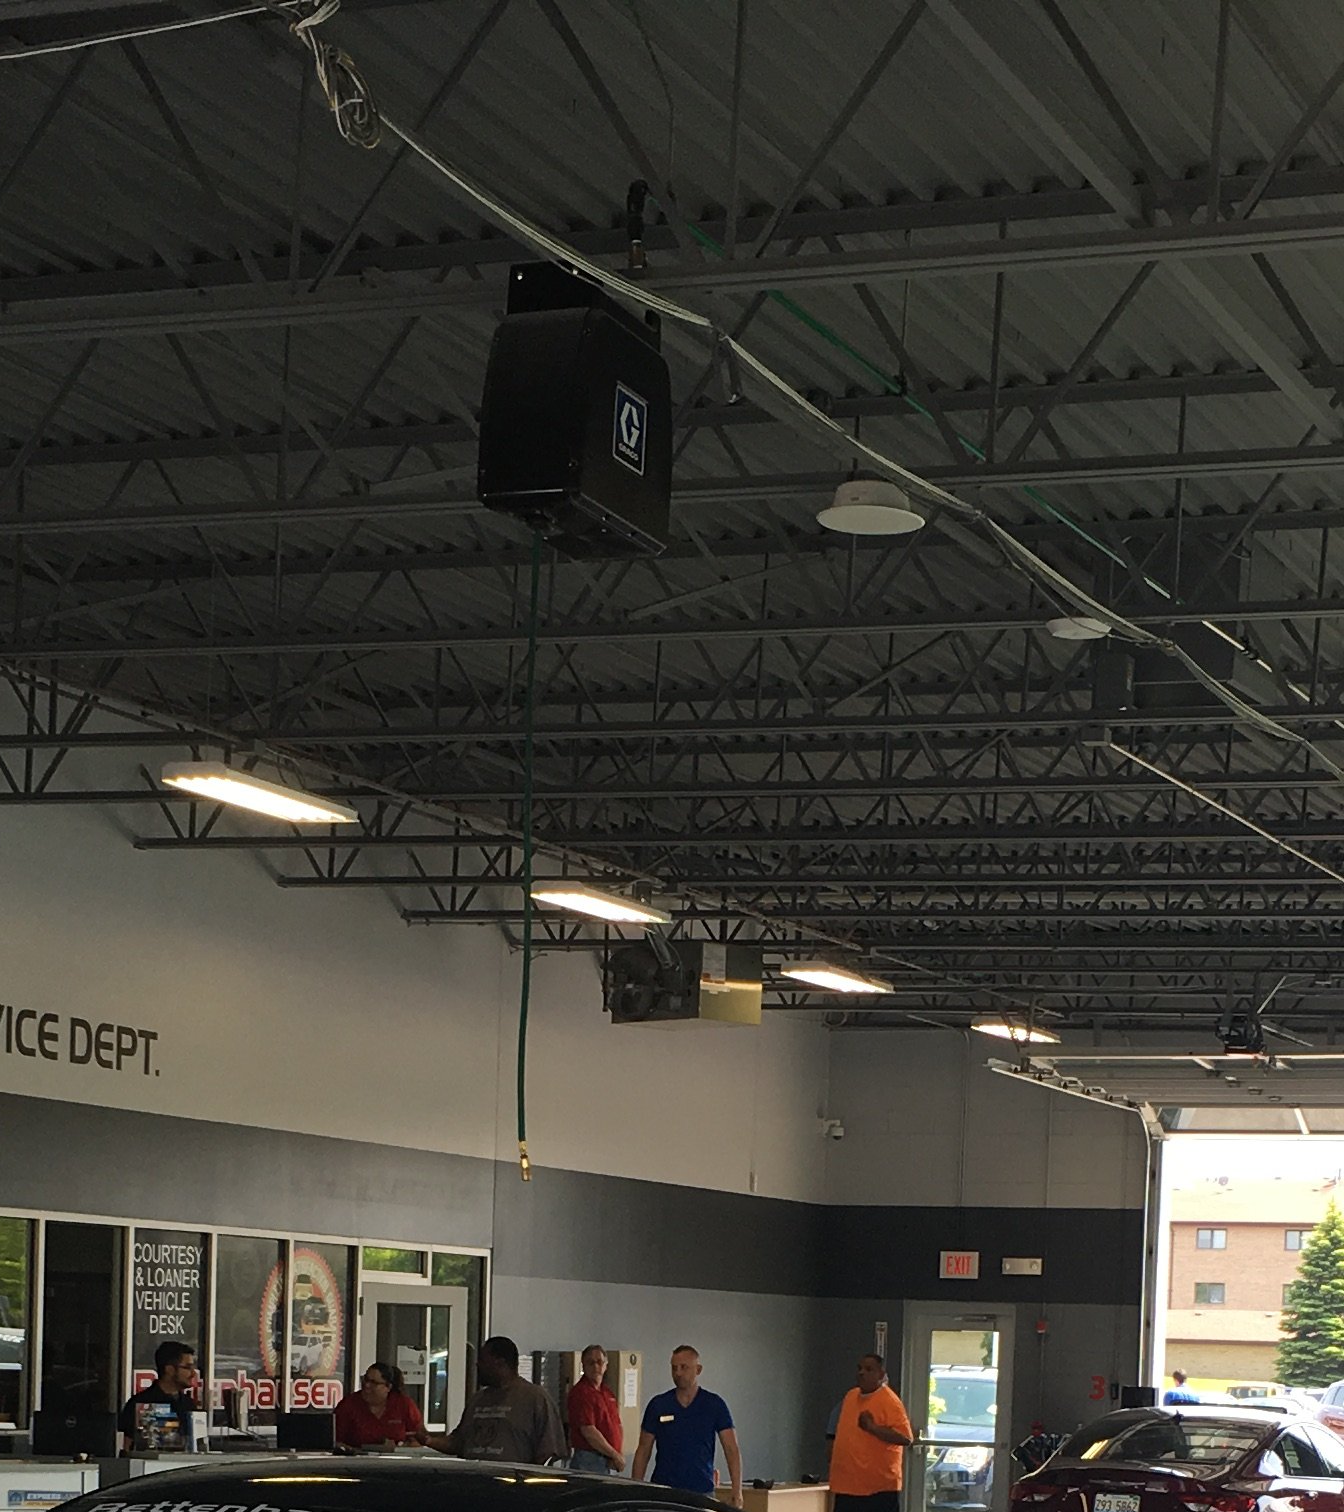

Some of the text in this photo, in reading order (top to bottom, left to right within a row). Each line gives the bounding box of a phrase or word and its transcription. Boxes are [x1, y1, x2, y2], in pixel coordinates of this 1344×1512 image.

[70, 1017, 160, 1077] DEPT.
[133, 1242, 204, 1266] COURTESY
[946, 1255, 972, 1275] EXIT
[136, 1267, 200, 1289] & LOANER
[135, 1291, 191, 1311] VEHICLE
[149, 1315, 185, 1335] DESK
[1089, 1375, 1105, 1400] 3
